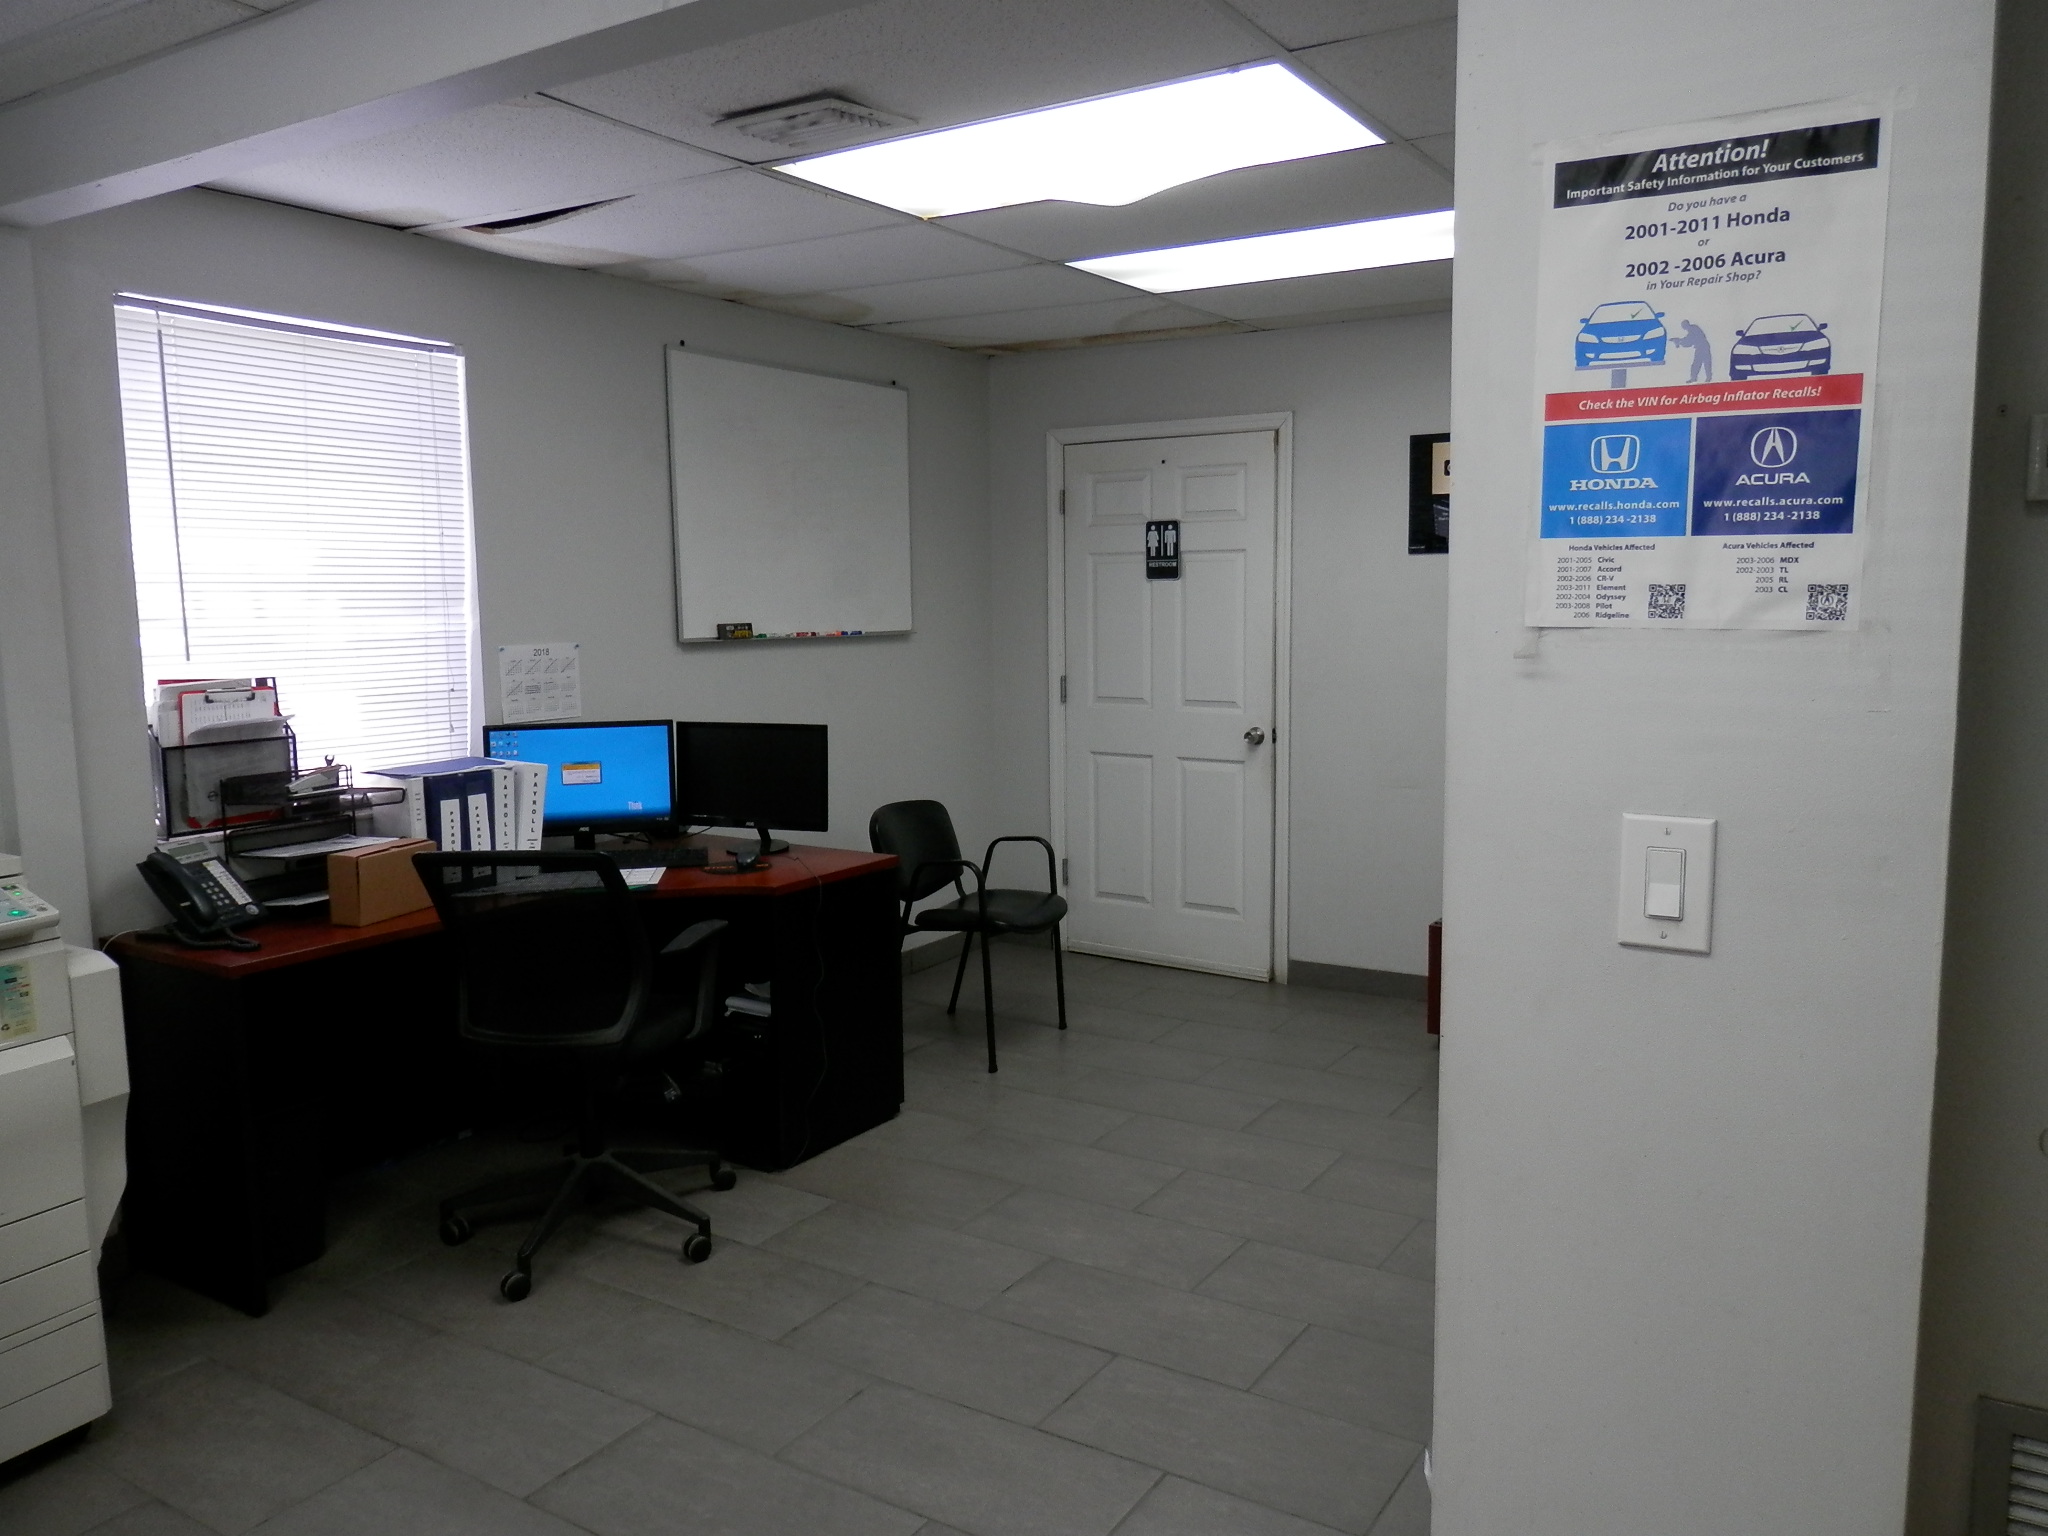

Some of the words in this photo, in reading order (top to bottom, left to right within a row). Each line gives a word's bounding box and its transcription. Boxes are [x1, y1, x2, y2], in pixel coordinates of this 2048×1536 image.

[1651, 138, 1770, 173] Attention!
[1566, 183, 1625, 200] Important
[1627, 178, 1665, 192] Safety
[1667, 169, 1739, 187] Information
[1742, 165, 1761, 177] for
[1763, 162, 1792, 174] Your
[1794, 152, 1864, 169] Customers
[1667, 202, 1684, 212] Do
[1685, 200, 1707, 213] you
[1708, 194, 1737, 207] have
[1739, 194, 1747, 202] a
[1625, 215, 1720, 240] 2001-2011
[1726, 206, 1791, 228] Honda
[1697, 238, 1710, 247] or
[1625, 260, 1670, 278] 2002
[1730, 250, 1786, 267] Acura
[1646, 281, 1657, 291] in
[1660, 278, 1685, 290] Your
[1686, 273, 1724, 287] Repair
[1725, 270, 1762, 283] Shop?
[1578, 399, 1613, 411] Check
[1615, 398, 1635, 409] the
[1637, 396, 1659, 407] VIN
[1660, 394, 1677, 406] for
[1679, 392, 1721, 405] Airbag
[1723, 390, 1770, 402] Inflator
[1772, 386, 1822, 399] Recalls!
[1569, 477, 1658, 491] HONDA
[1735, 472, 1810, 486] ACURA
[1548, 500, 1680, 512] www.recalls.honda.com
[1703, 496, 1844, 508] www.recalls.acura.com
[1577, 515, 1603, 526] (888)
[1605, 515, 1624, 524] 234
[1724, 513, 1729, 522] 1
[1732, 512, 1761, 522] (888)
[1763, 511, 1785, 521] 234
[1595, 593, 1626, 601] Odyssey
[533, 648, 550, 657] 2018
[530, 772, 538, 833] PAYROLL
[449, 811, 457, 851] PAYROL
[474, 806, 482, 851] PAYROL
